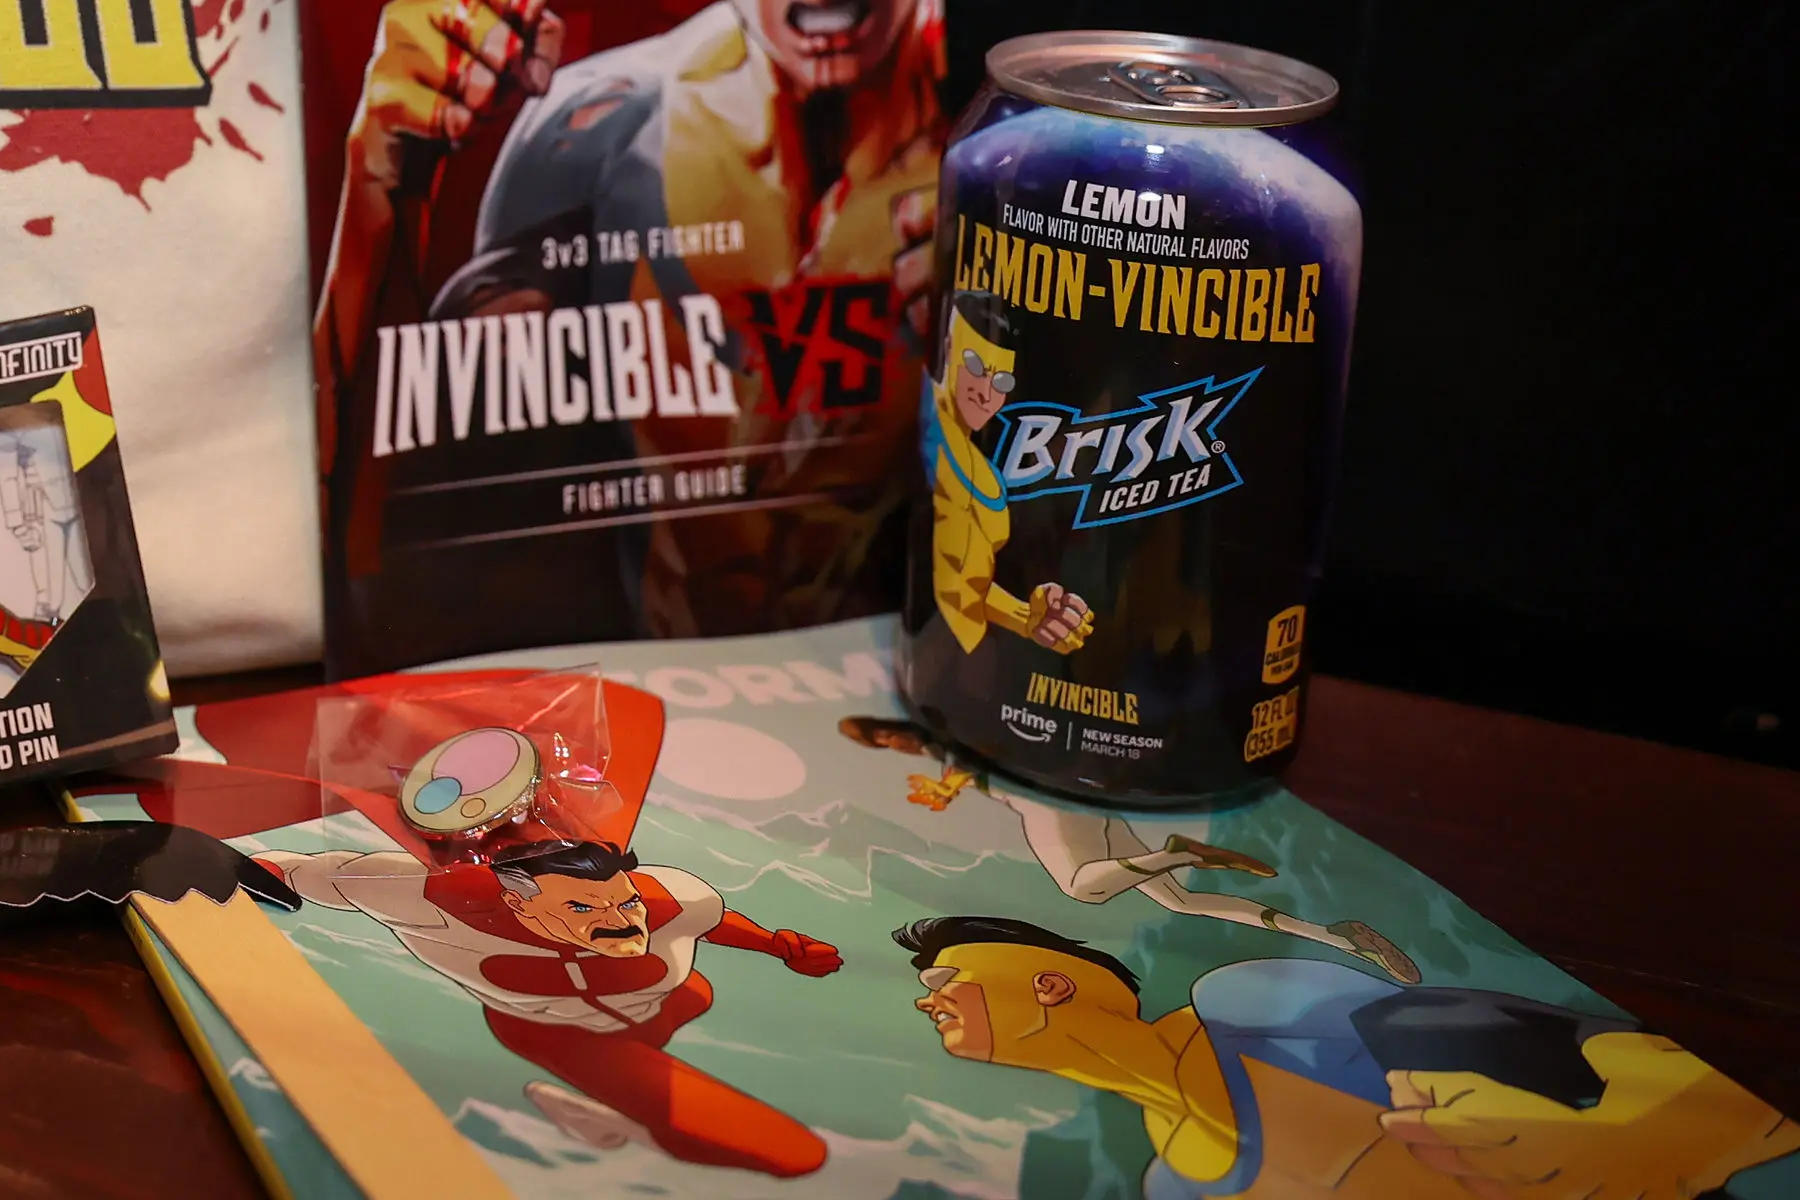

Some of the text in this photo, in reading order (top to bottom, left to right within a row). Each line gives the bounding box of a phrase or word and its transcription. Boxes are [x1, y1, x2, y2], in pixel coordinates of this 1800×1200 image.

[1061, 179, 1186, 230] LEMON
[597, 229, 640, 264] TAG
[647, 220, 745, 258] FIGHTER
[1003, 203, 1250, 261] FLAVOR WITH OTHER NATURAL FLAVORS
[954, 213, 1321, 344] LEMON-VINCIBLE
[372, 281, 891, 458] INVINCIBLE VS
[562, 463, 747, 515] FIGHTER GUIDE
[1098, 463, 1212, 514] ICED TEA
[1277, 614, 1298, 647] 70
[591, 651, 894, 710] ORM
[1026, 671, 1140, 726] INVINCIBLE
[1001, 703, 1058, 734] prime
[1081, 727, 1164, 750] NEW SEASON
[17, 735, 61, 766] PIN
[1080, 740, 1141, 760] MARCH 18
